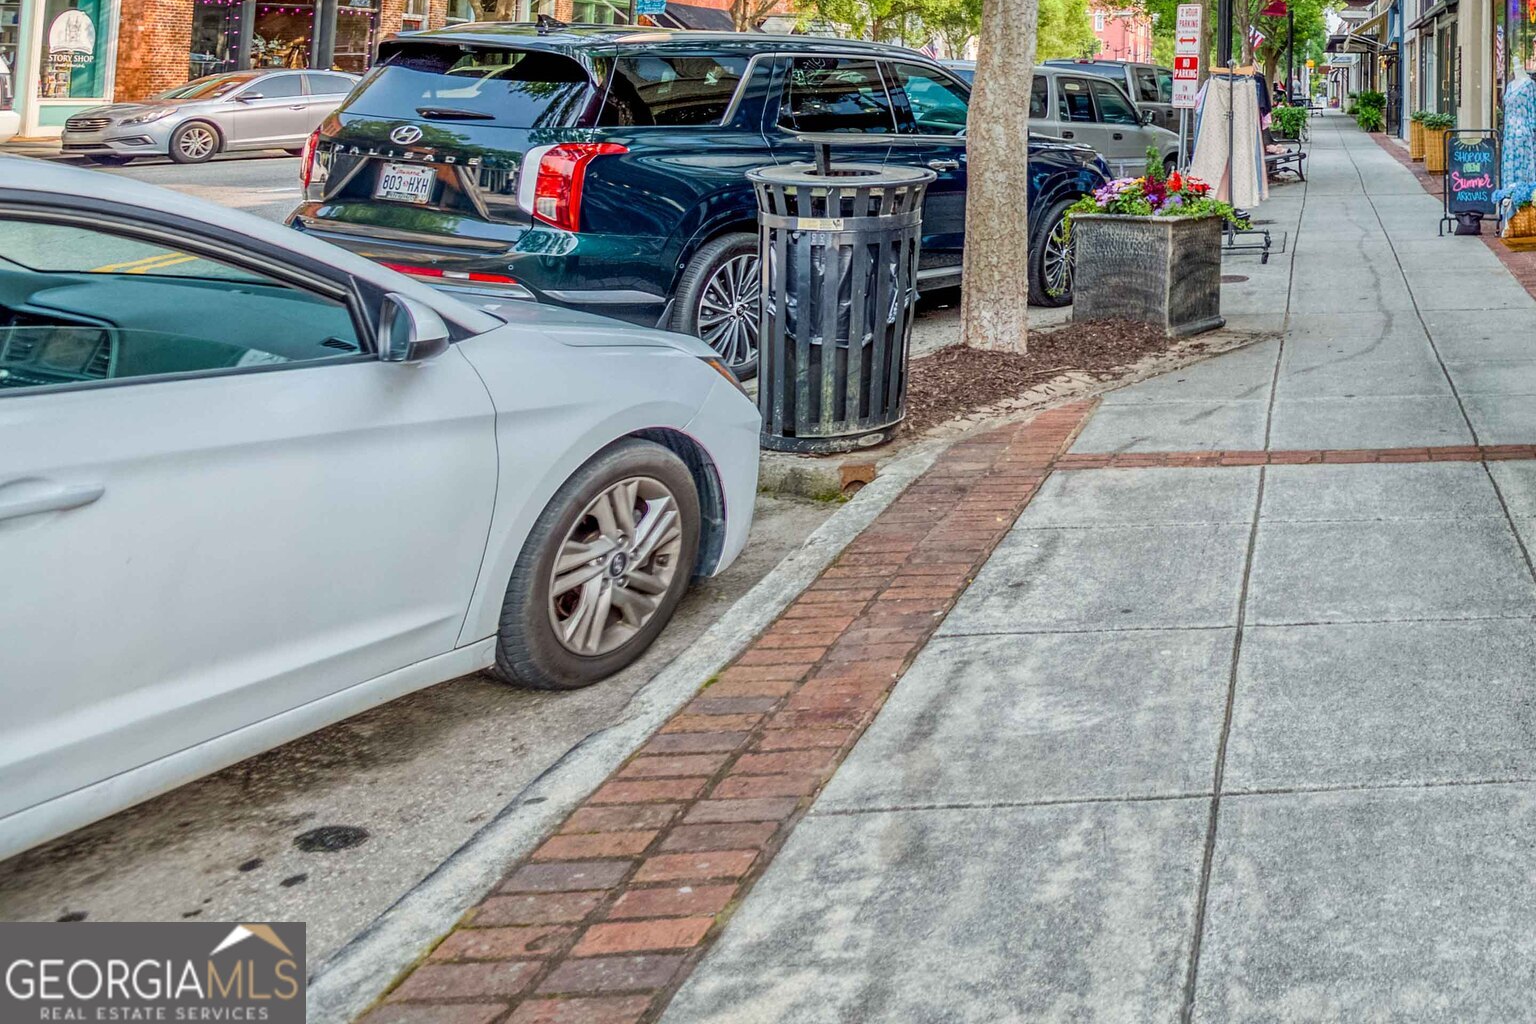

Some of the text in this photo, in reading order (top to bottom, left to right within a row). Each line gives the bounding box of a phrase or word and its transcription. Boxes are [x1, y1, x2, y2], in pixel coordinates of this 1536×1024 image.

[1179, 20, 1199, 28] PARKING
[48, 55, 95, 63] STORY SHOP
[1182, 58, 1191, 68] NO
[1175, 69, 1197, 79] PARKING
[335, 144, 481, 166] PALISADE
[1454, 151, 1491, 163] SHOP OUR
[382, 174, 429, 193] 803 HXH
[1452, 171, 1493, 191] Summer
[1456, 191, 1488, 201] ARRIVALS
